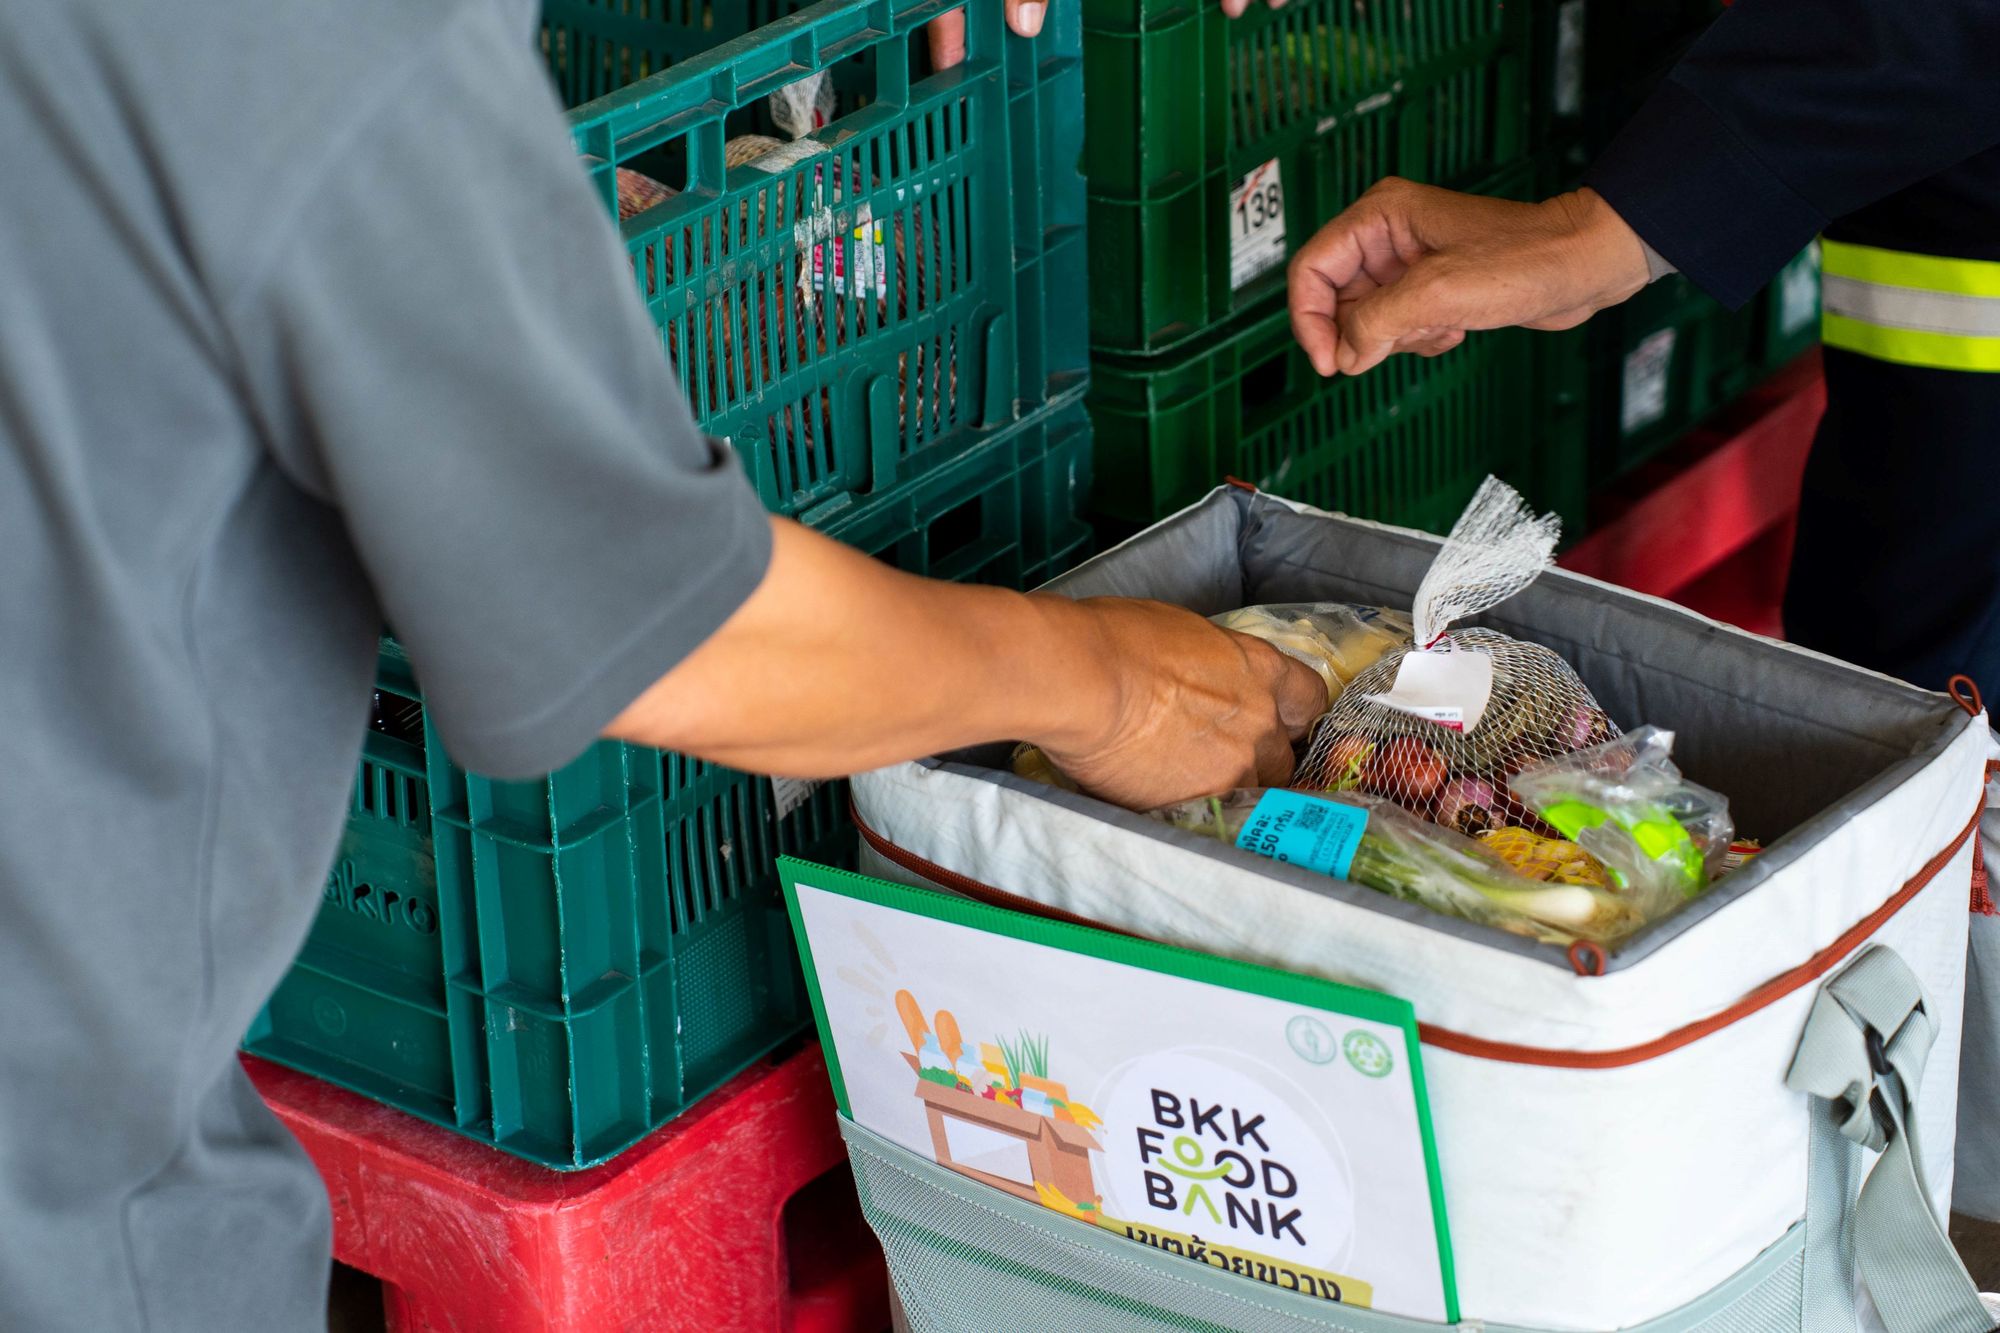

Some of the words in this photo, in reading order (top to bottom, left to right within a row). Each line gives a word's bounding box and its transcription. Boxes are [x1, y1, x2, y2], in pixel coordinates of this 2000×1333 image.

[1237, 183, 1281, 234] 138
[323, 858, 438, 936] akro
[1150, 1087, 1270, 1153] BKK
[1136, 1126, 1298, 1200] FOOD
[1143, 1169, 1307, 1247] BANK
